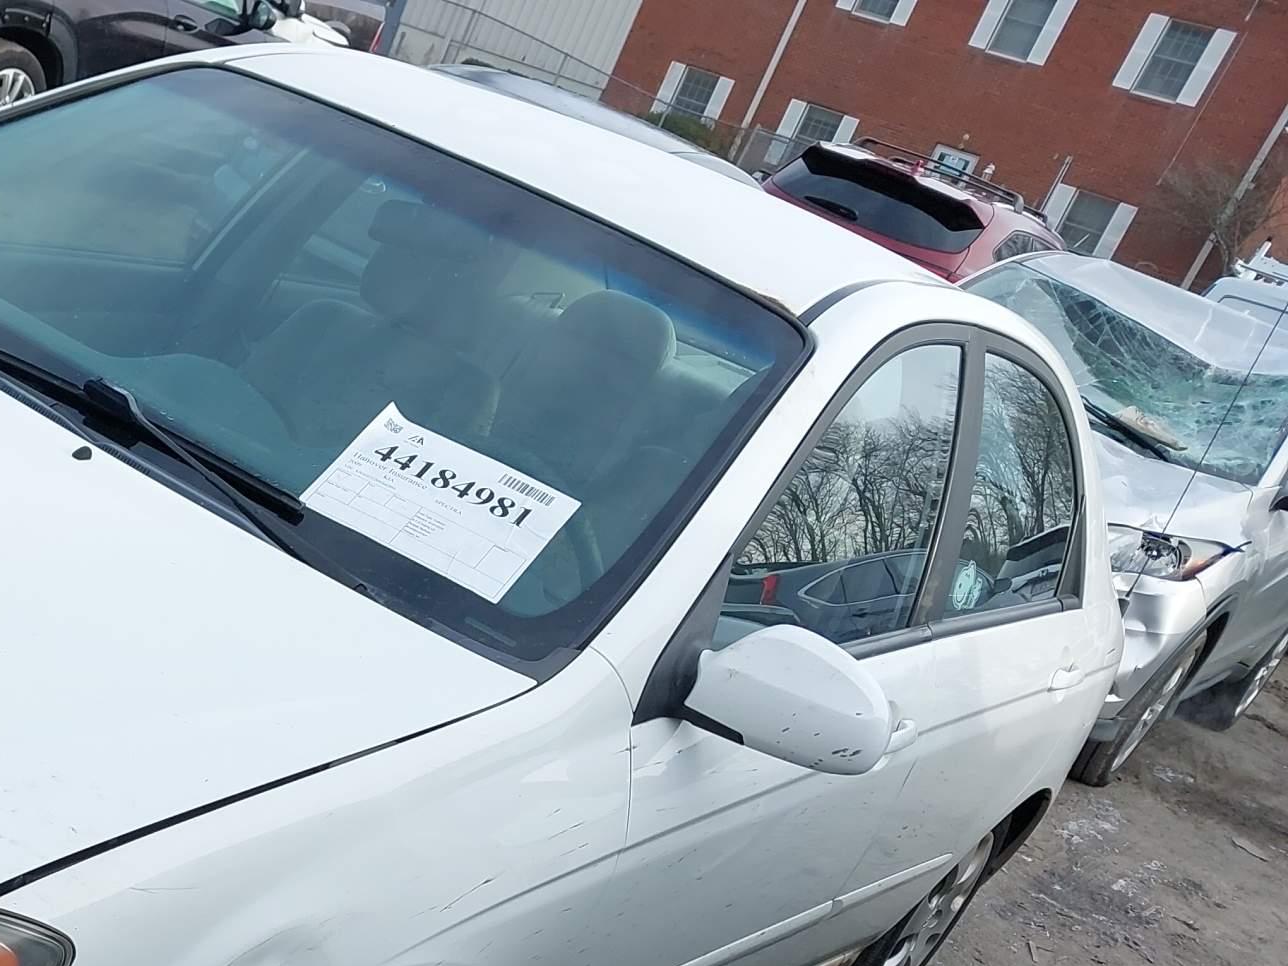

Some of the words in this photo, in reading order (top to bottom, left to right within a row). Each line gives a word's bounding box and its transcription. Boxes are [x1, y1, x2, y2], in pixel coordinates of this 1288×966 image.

[353, 451, 387, 472] Hanover
[388, 467, 428, 490] Insurance
[374, 445, 533, 528] 44184981
